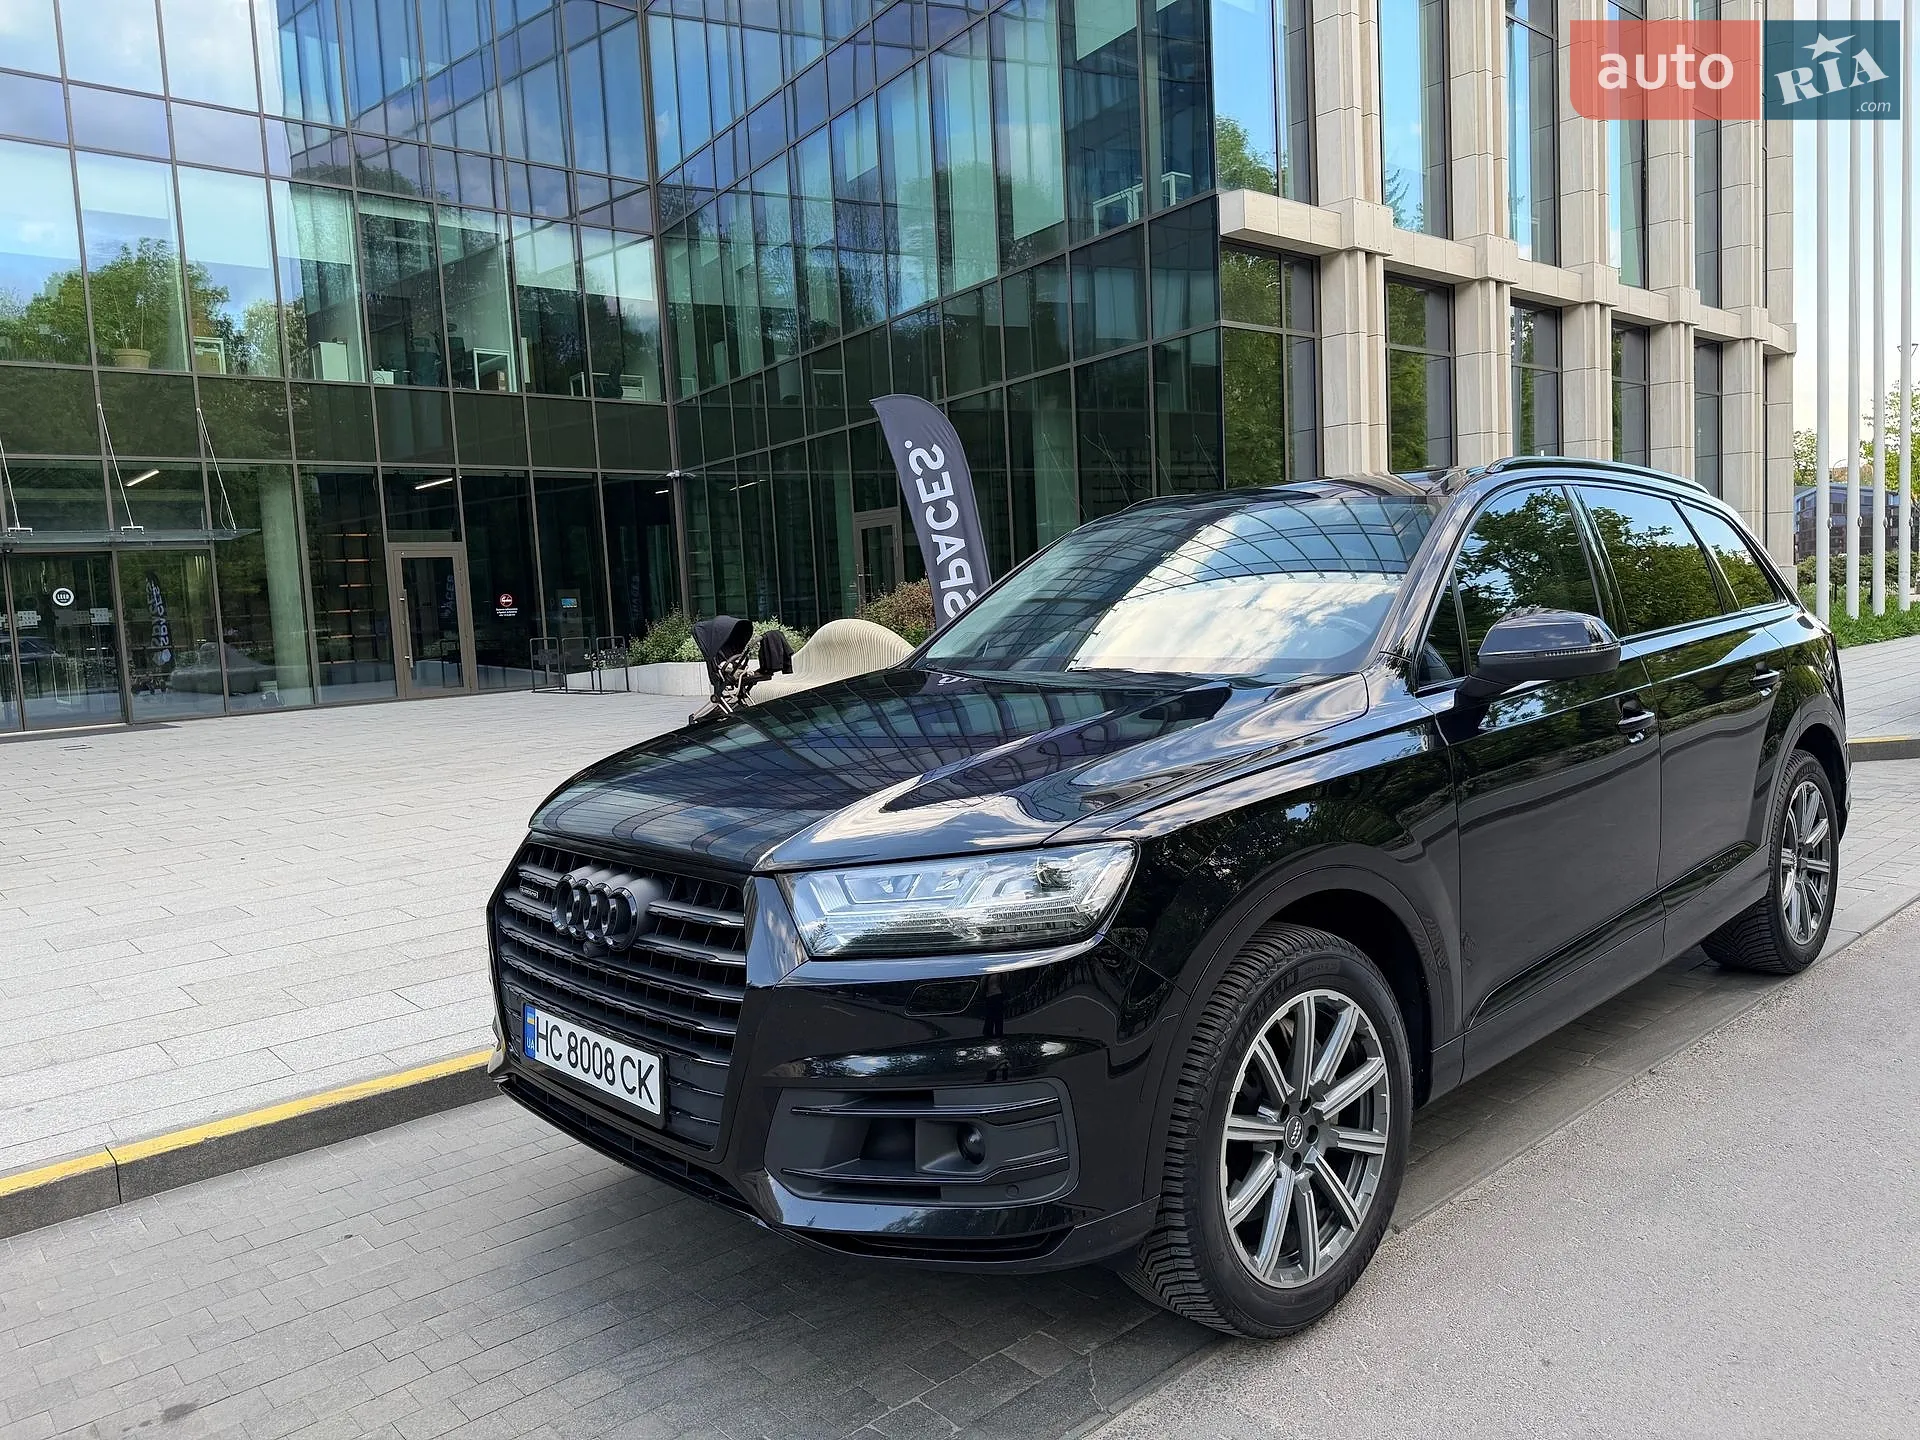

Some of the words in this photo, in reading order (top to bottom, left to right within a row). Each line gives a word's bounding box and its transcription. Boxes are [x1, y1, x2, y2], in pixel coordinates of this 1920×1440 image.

[526, 1037, 535, 1050] UA
[536, 1016, 563, 1061] HC
[567, 1031, 616, 1086] 8008
[620, 1055, 656, 1106] CK
